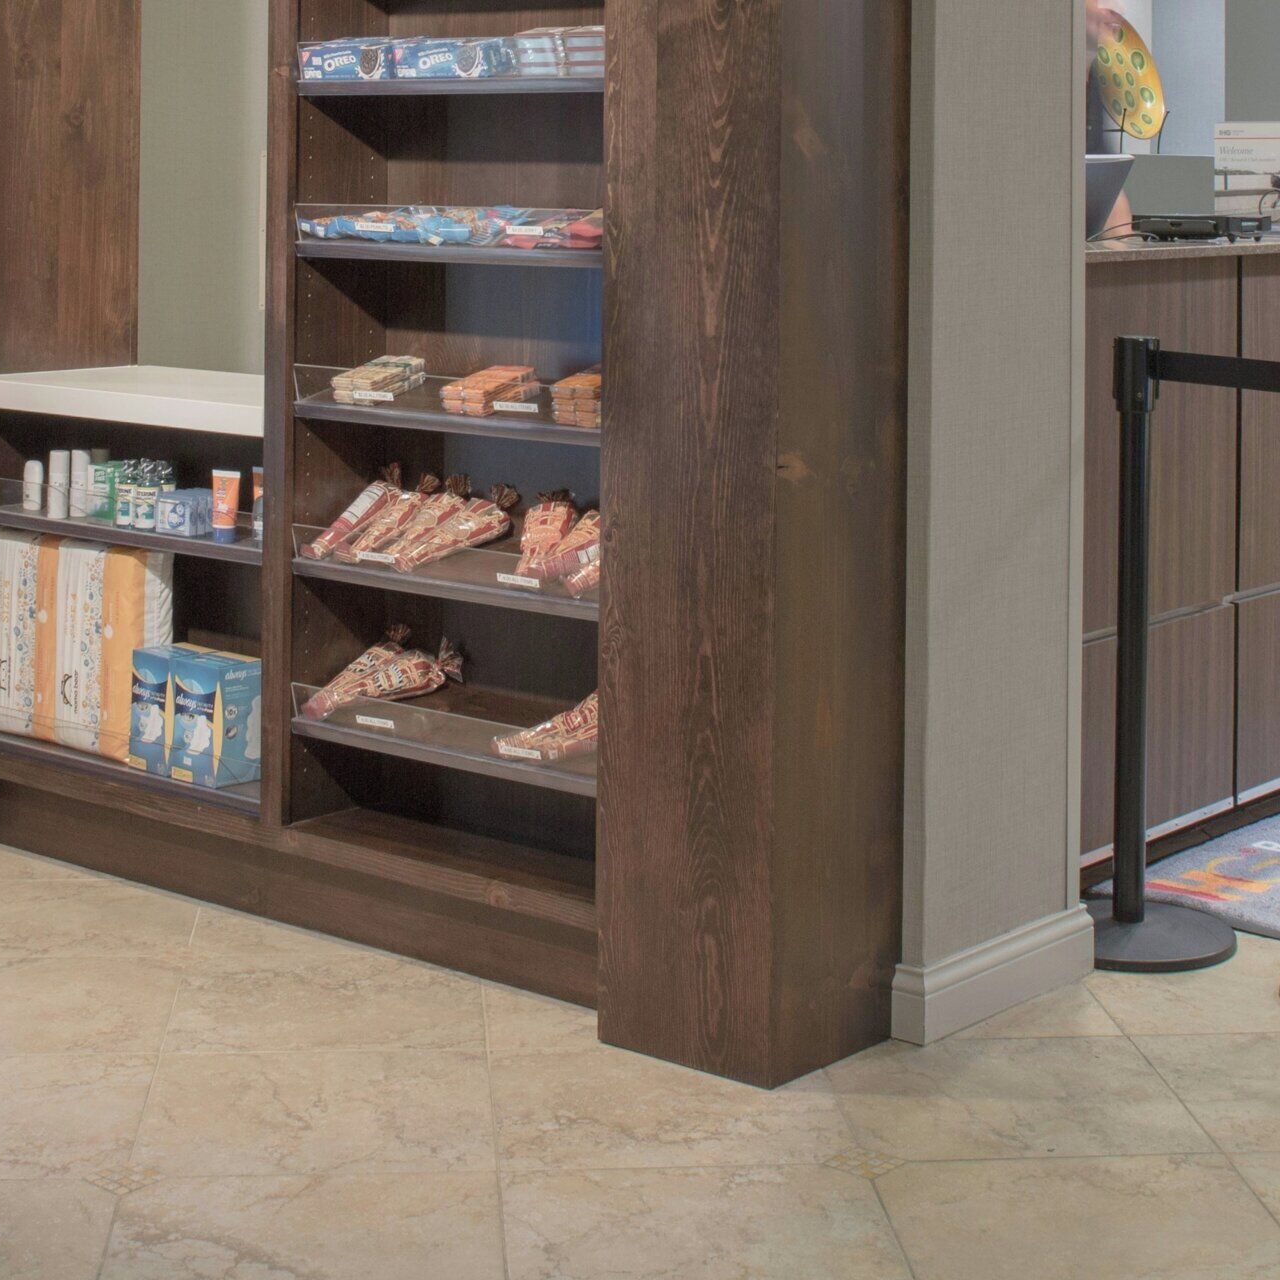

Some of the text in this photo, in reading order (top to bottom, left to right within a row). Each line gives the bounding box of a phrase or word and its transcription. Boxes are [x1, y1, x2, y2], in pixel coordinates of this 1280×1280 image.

[323, 56, 356, 72] OREO
[418, 53, 453, 70] OREO
[225, 669, 247, 681] always
[132, 683, 151, 701] always
[175, 693, 197, 711] always
